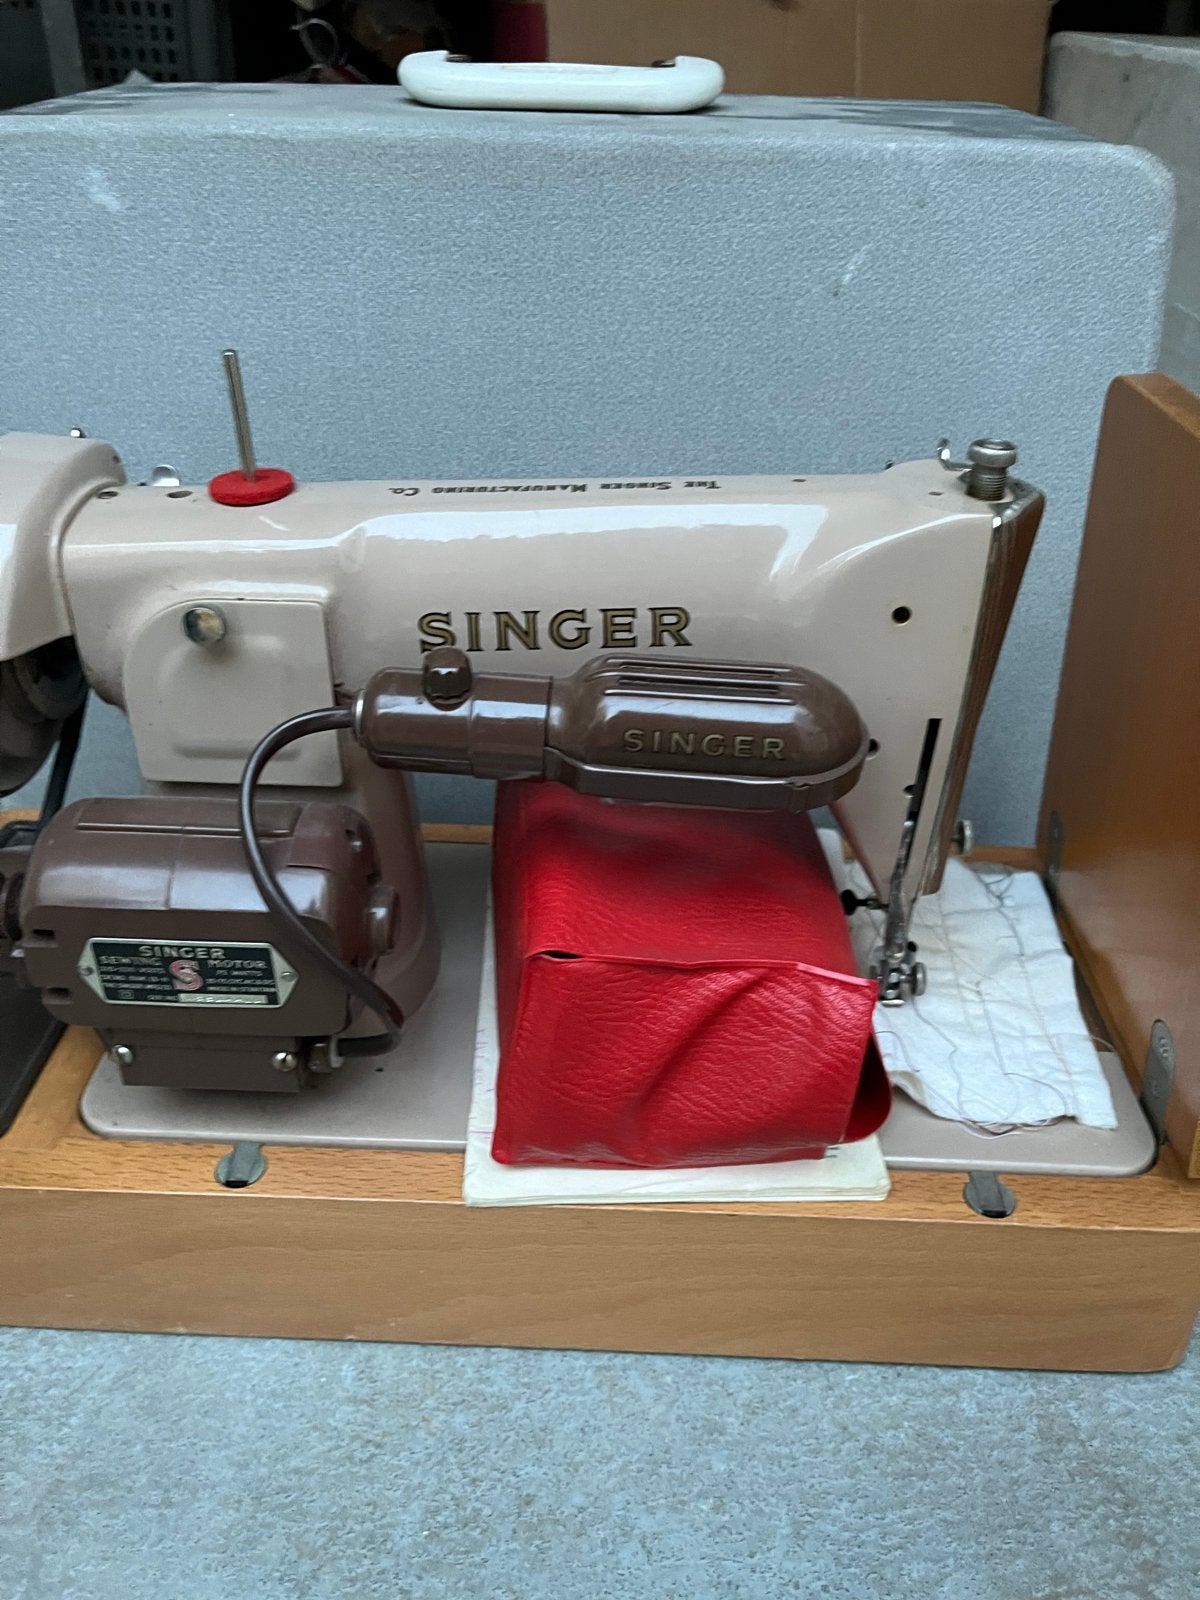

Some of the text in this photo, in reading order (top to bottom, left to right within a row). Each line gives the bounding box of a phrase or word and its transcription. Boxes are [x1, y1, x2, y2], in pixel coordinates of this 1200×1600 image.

[417, 606, 693, 654] SINGER
[623, 729, 786, 760] SINGER
[138, 945, 227, 960] SINGER
[207, 959, 269, 969] MOTOR
